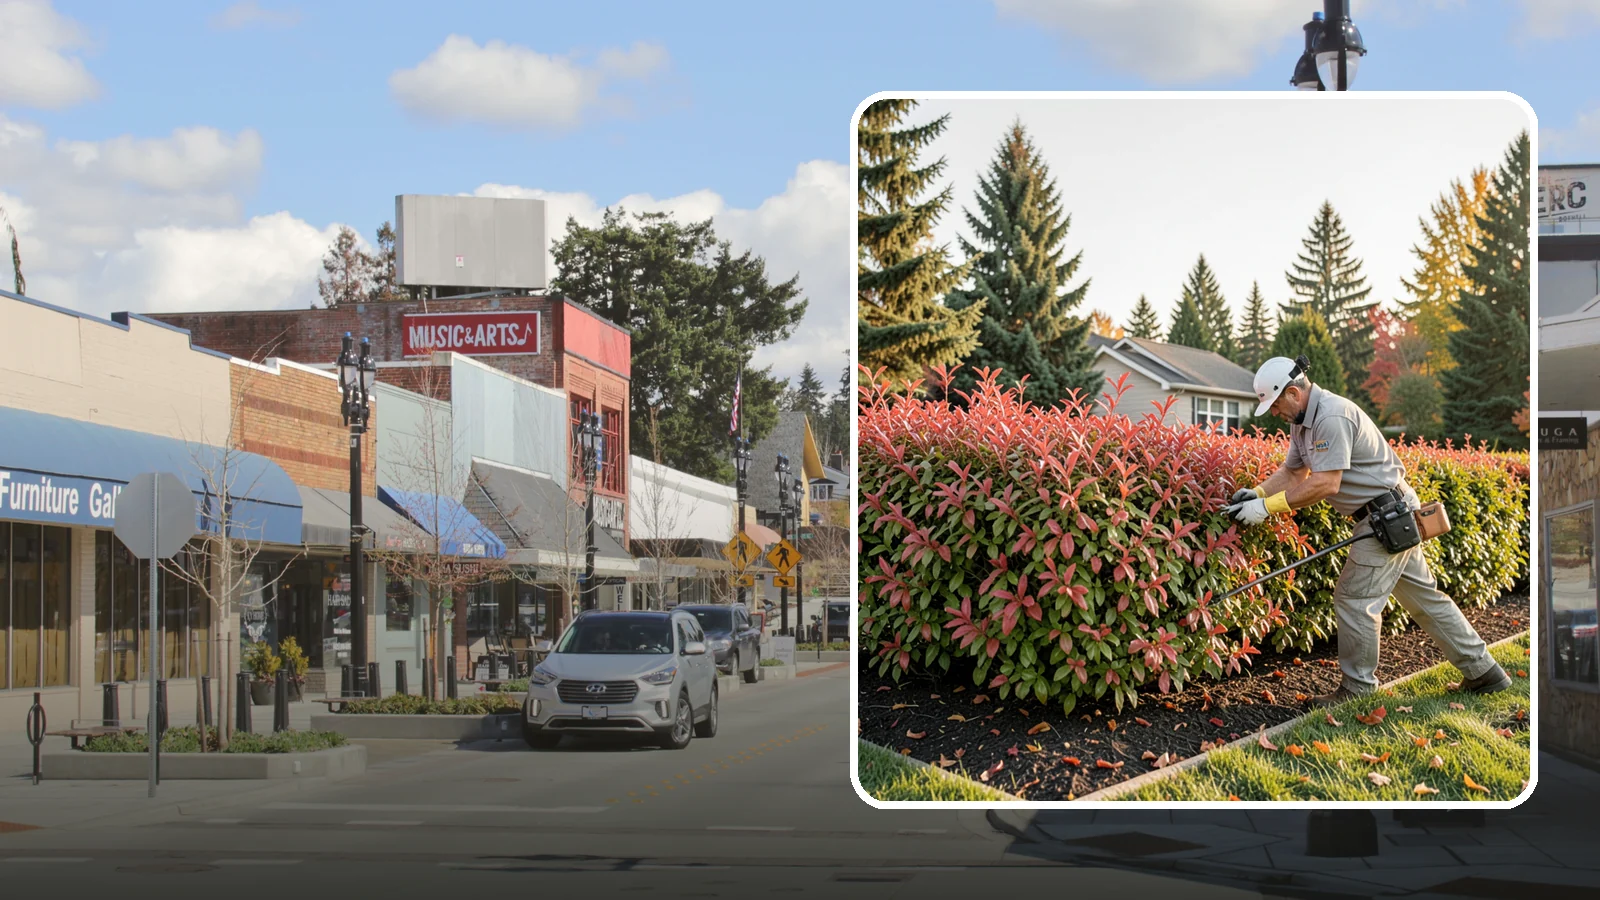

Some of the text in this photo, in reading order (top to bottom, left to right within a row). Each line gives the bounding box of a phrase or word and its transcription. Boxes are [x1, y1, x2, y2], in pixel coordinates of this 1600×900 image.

[409, 323, 519, 349] MUSIC&ARTS
[0, 471, 122, 519] Furniture Gal
